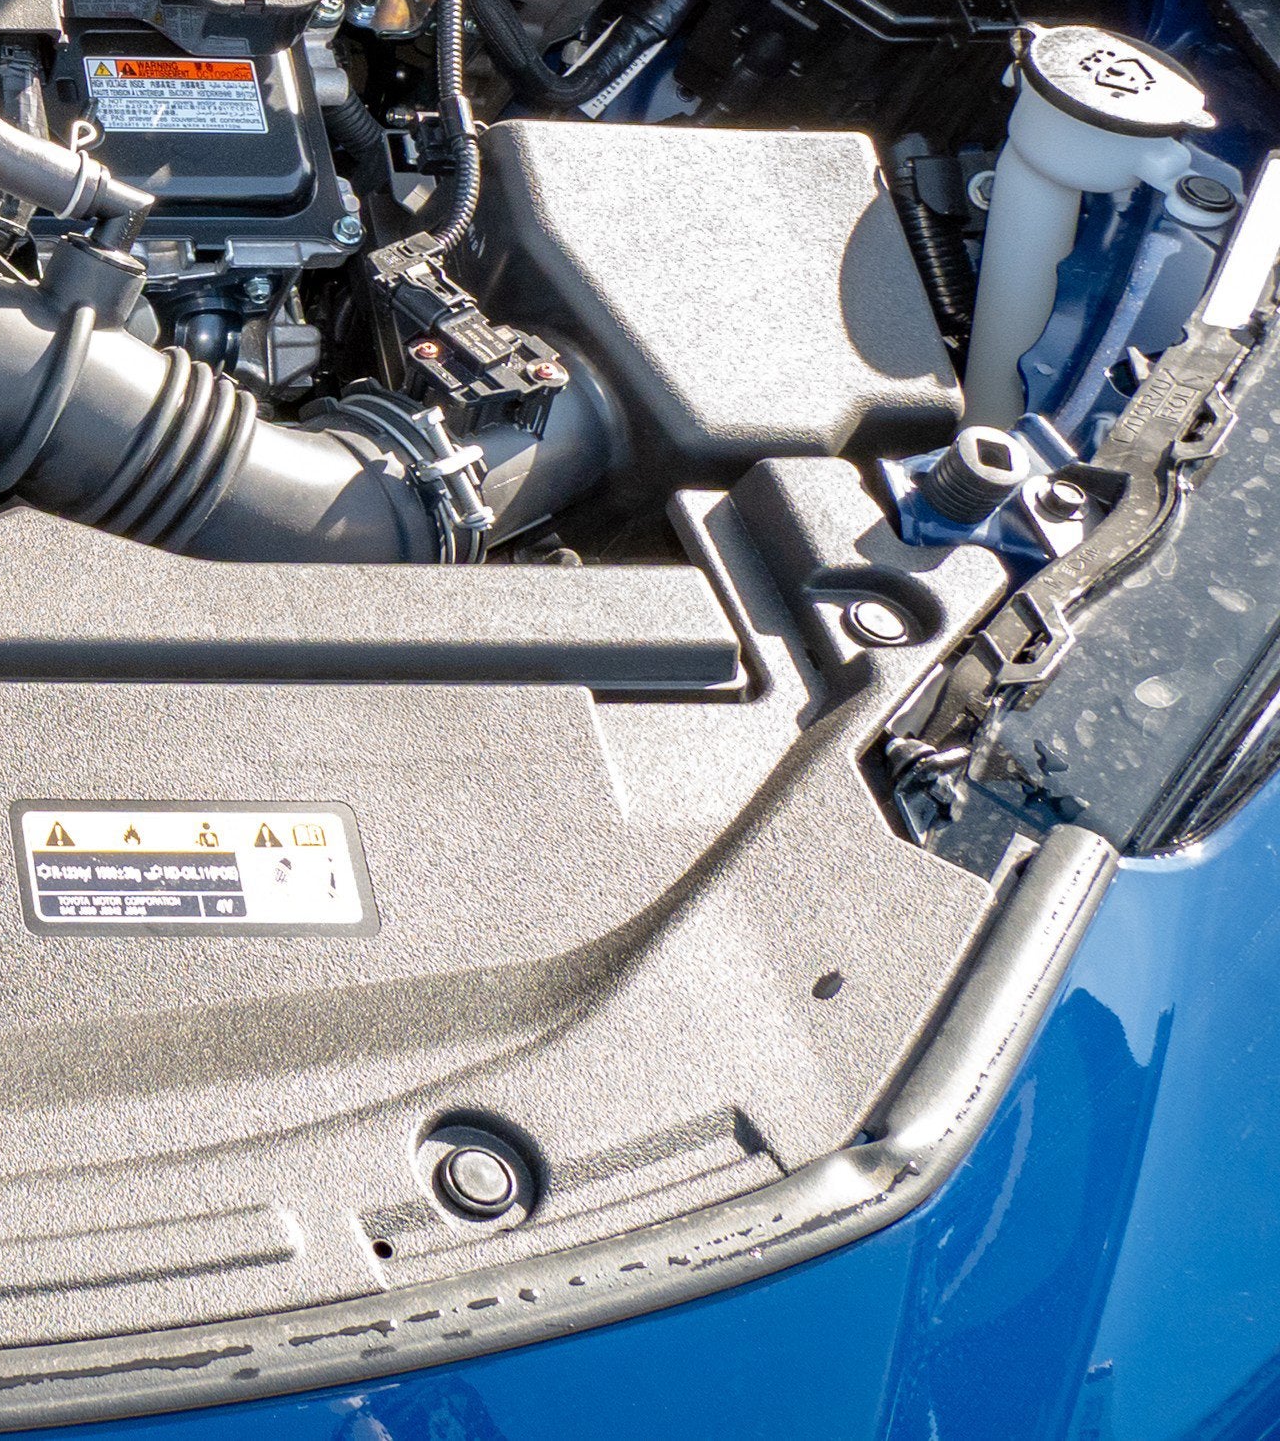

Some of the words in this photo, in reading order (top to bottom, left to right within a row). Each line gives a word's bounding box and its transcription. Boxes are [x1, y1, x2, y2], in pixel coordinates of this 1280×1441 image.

[137, 61, 178, 70] WARNING
[106, 80, 128, 89] VOLTAGE
[58, 896, 90, 906] TOYOTA
[92, 896, 122, 906] MOTOR
[124, 896, 182, 906] CORPORATION
